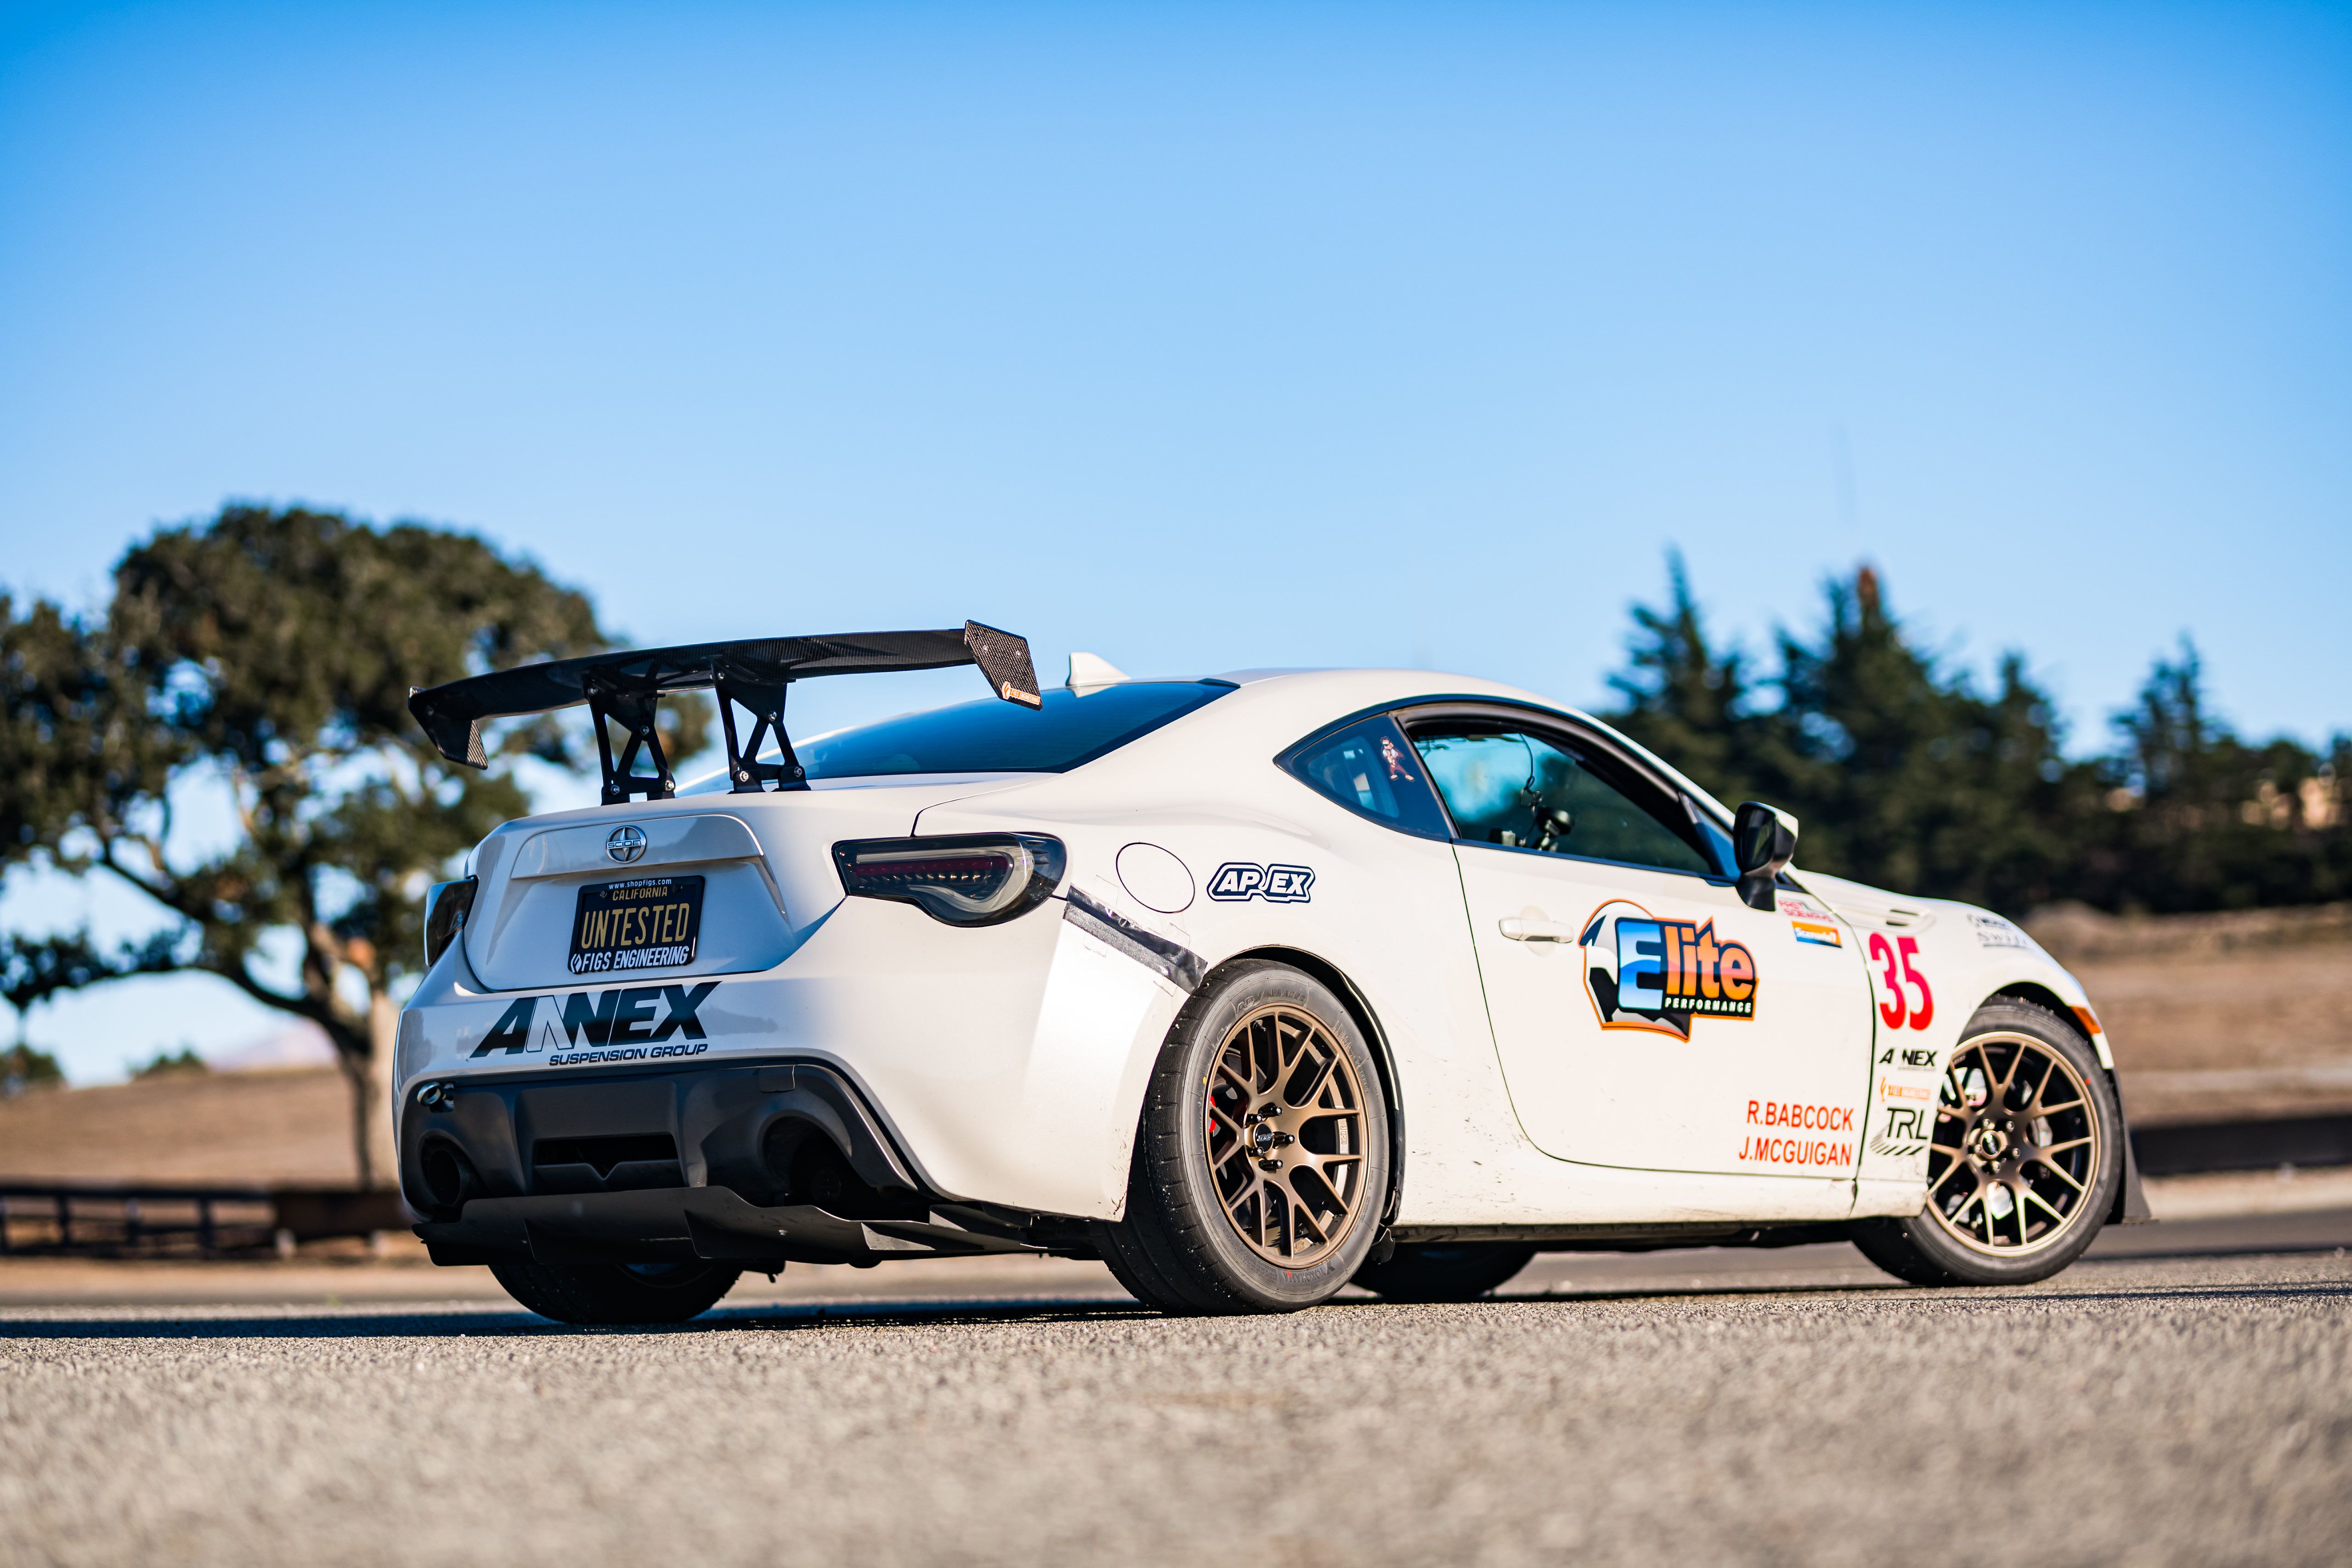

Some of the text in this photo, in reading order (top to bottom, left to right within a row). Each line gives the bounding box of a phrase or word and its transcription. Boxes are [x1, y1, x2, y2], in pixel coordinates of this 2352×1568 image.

[608, 840, 641, 848] SCION
[609, 878, 672, 890] www.shopfigs.com
[612, 886, 667, 901] CALIFORNIA
[582, 903, 690, 949] UNTESTED
[582, 946, 689, 971] FIGS ENGINEERING
[1617, 921, 1753, 1010] Elite
[1869, 932, 1934, 1031] 35
[1237, 989, 1281, 1012] ADVAN
[1665, 998, 1751, 1013] PERFORMANCE
[469, 981, 723, 1058] ANNEX
[549, 1043, 708, 1066] SUSPENSION GROUP
[1747, 1100, 1854, 1131] R.BABCOCK
[1887, 1107, 1928, 1140] TRL
[1739, 1136, 1852, 1166] J.MCGUIGAN
[1282, 1268, 1326, 1283] YOKOHAMA
